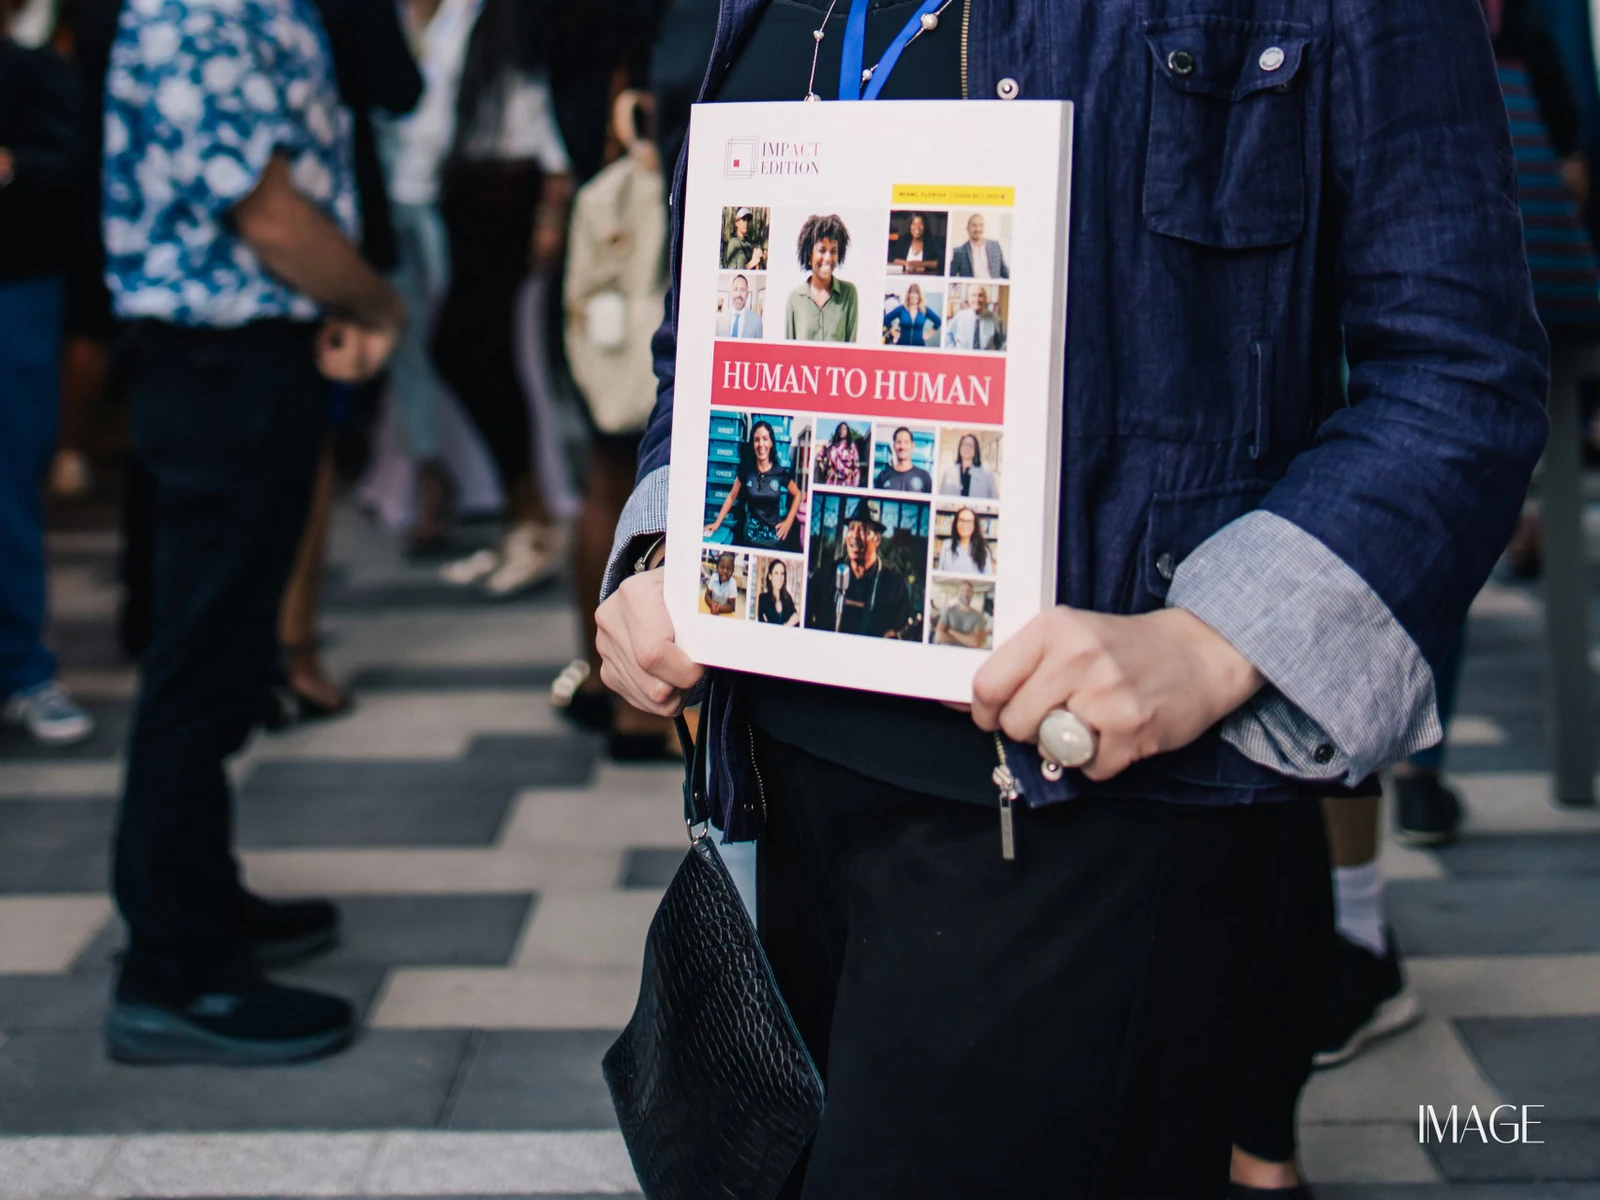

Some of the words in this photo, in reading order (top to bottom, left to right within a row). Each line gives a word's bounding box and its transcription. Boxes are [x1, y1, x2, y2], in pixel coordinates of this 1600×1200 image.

[761, 142, 822, 157] IMPACT
[760, 161, 820, 175] EDITION
[722, 360, 821, 395] HUMAN
[826, 366, 867, 398] TO
[873, 369, 992, 407] HUMAN
